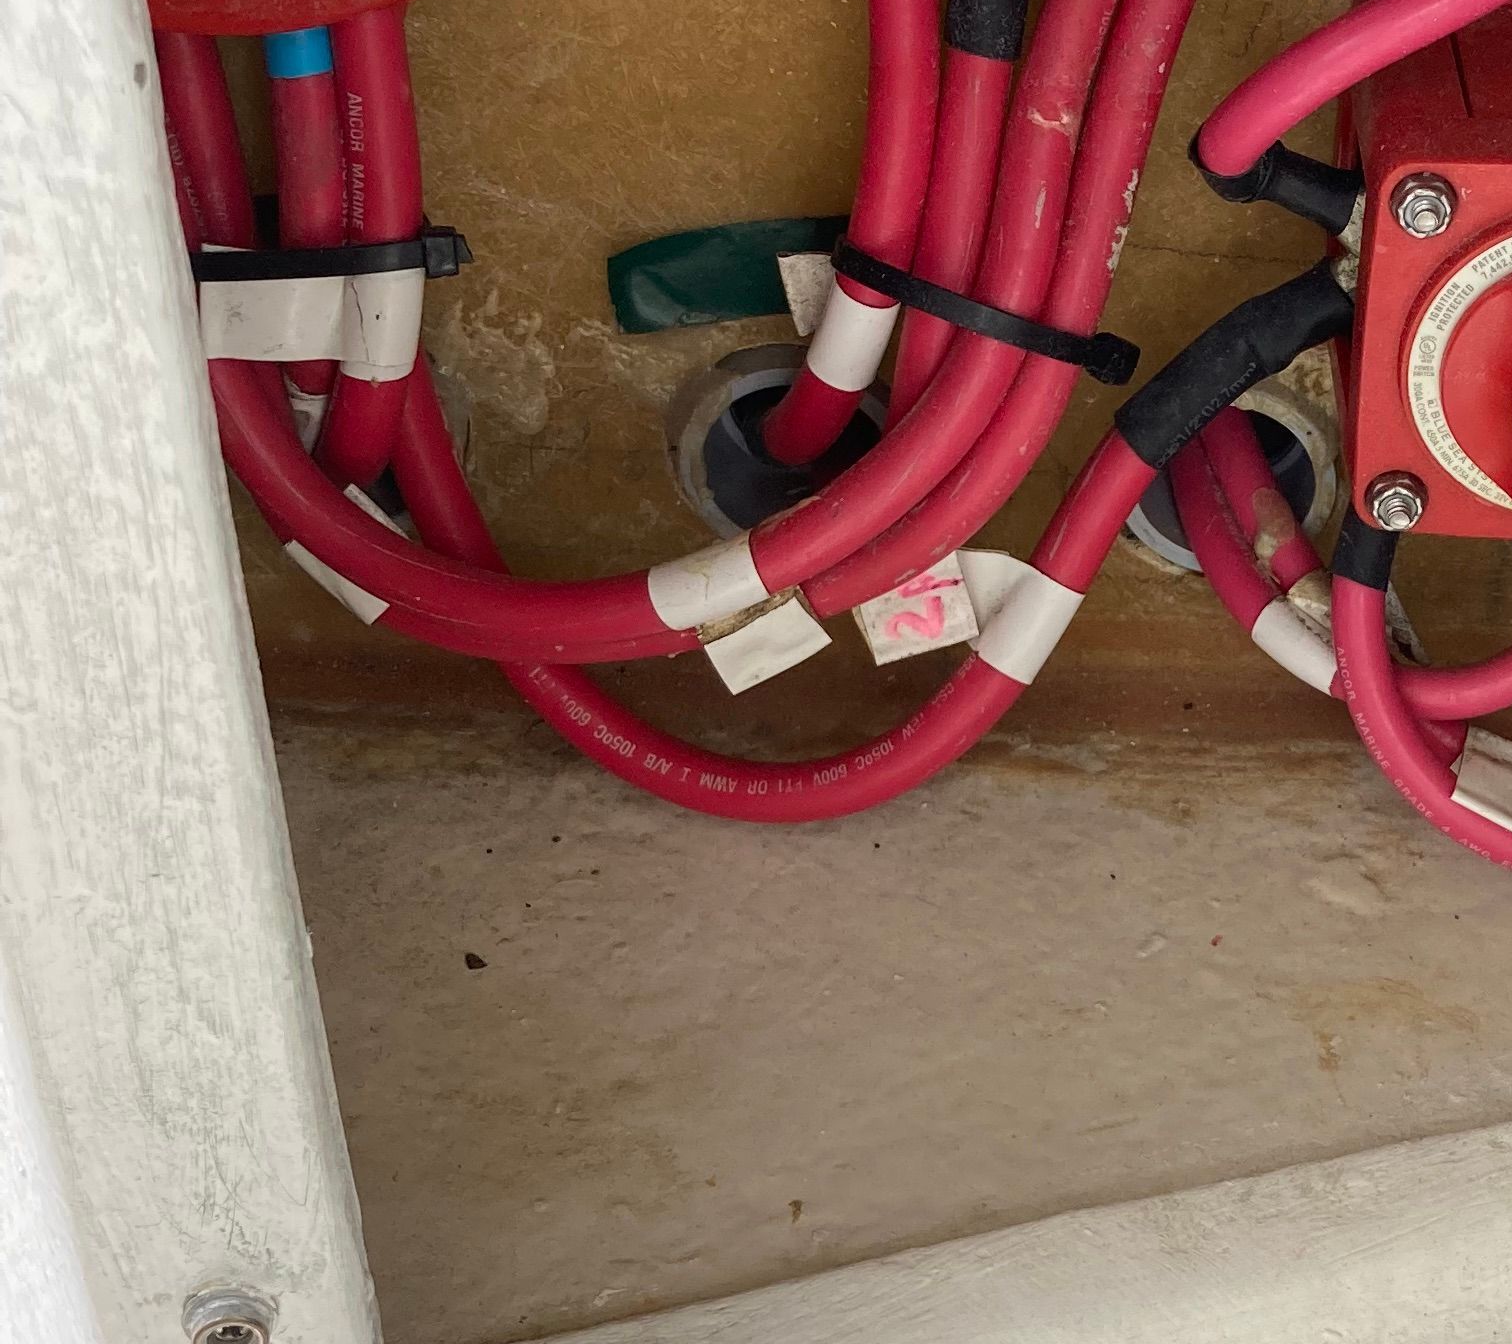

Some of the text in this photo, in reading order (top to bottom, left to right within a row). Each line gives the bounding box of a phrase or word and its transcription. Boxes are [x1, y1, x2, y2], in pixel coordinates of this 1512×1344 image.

[347, 92, 364, 229] ANCOR MARINE
[1471, 247, 1508, 273] PATENT
[1428, 282, 1461, 322] IGNITION
[1436, 283, 1475, 331] PROTECTED
[1430, 411, 1467, 464] BLUE SEA
[1336, 646, 1356, 702] ANCOR
[1354, 712, 1391, 770] MARINE
[1394, 778, 1434, 819] GRADE
[643, 752, 673, 775] A/B
[812, 763, 849, 788] 600V
[700, 771, 739, 793] AWM
[748, 779, 769, 796] OR
